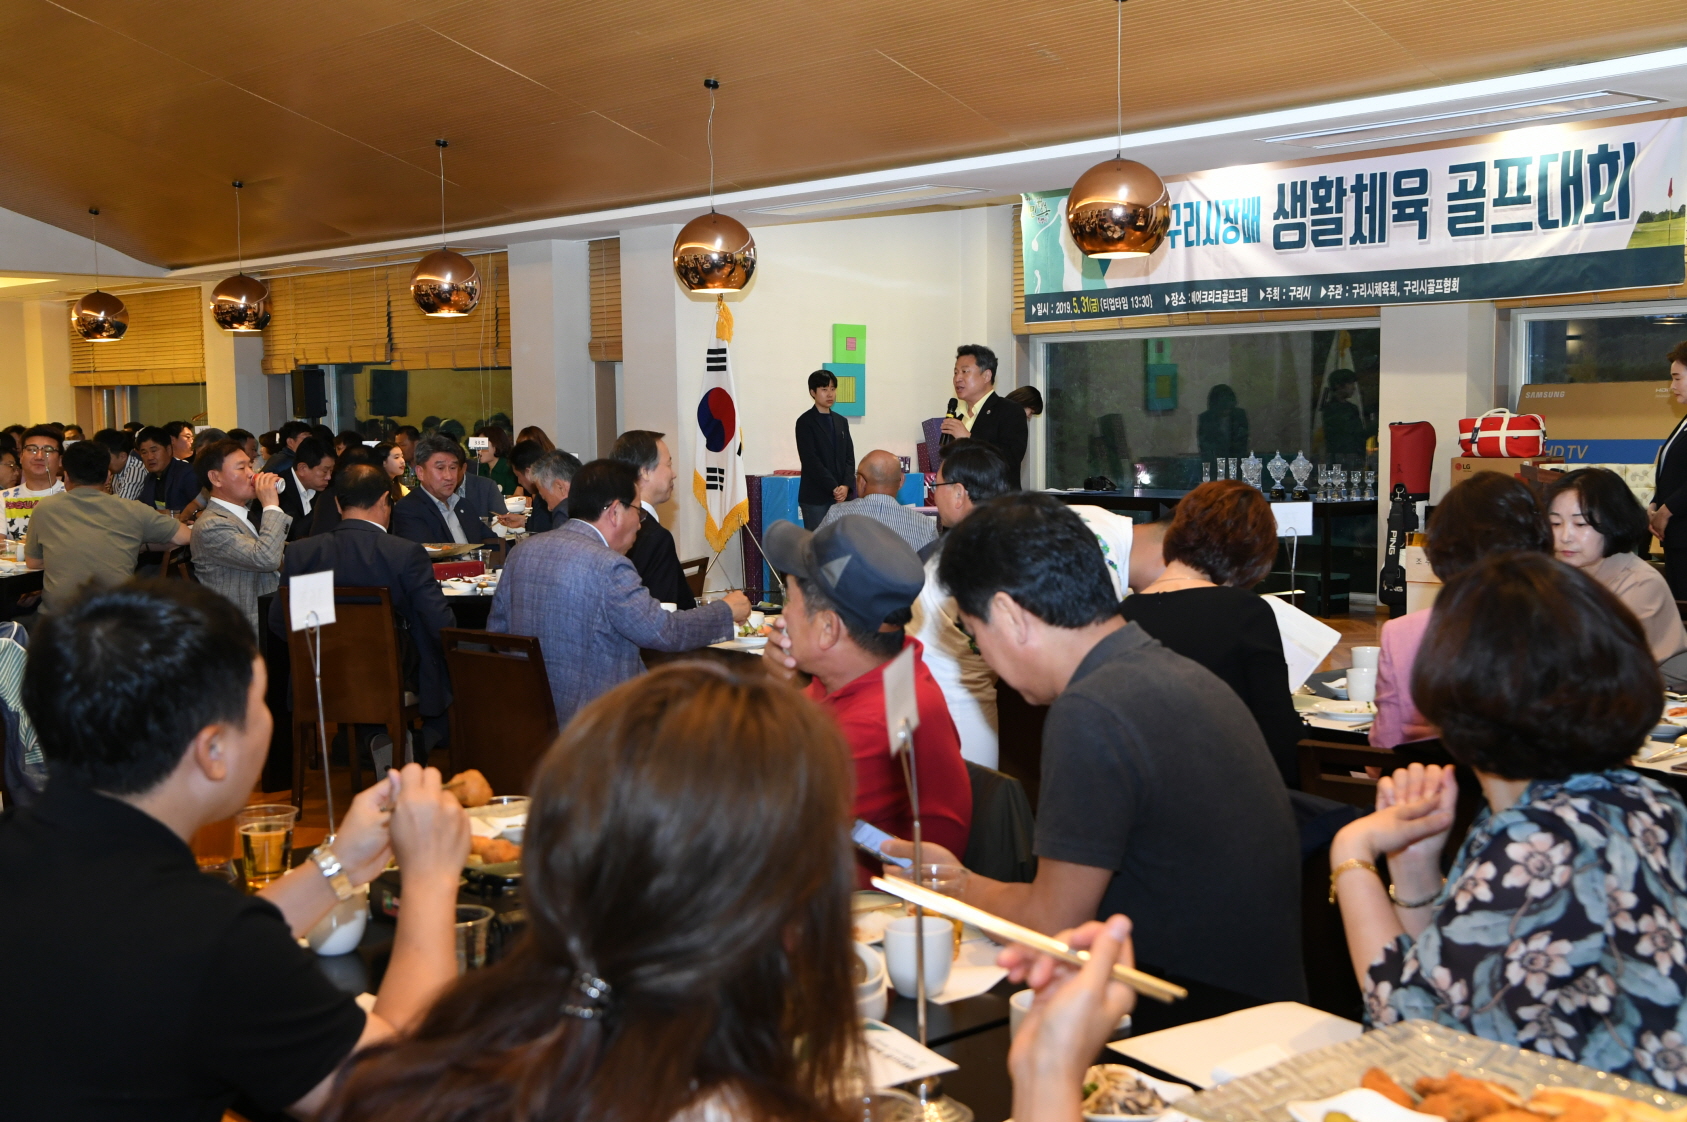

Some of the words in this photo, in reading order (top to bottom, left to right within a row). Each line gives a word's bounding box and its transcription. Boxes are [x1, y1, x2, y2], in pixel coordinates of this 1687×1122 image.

[1273, 168, 1430, 251] 생활체육
[1447, 142, 1636, 238] 골프대회
[1265, 286, 1281, 302] 주최
[1288, 285, 1312, 301] 구리시
[1327, 284, 1343, 300] 주관
[1403, 277, 1460, 297] 구리시골프협회
[1170, 291, 1187, 307] 장소
[1525, 391, 1566, 399] SAMSUNG
[1388, 530, 1398, 556] PING
